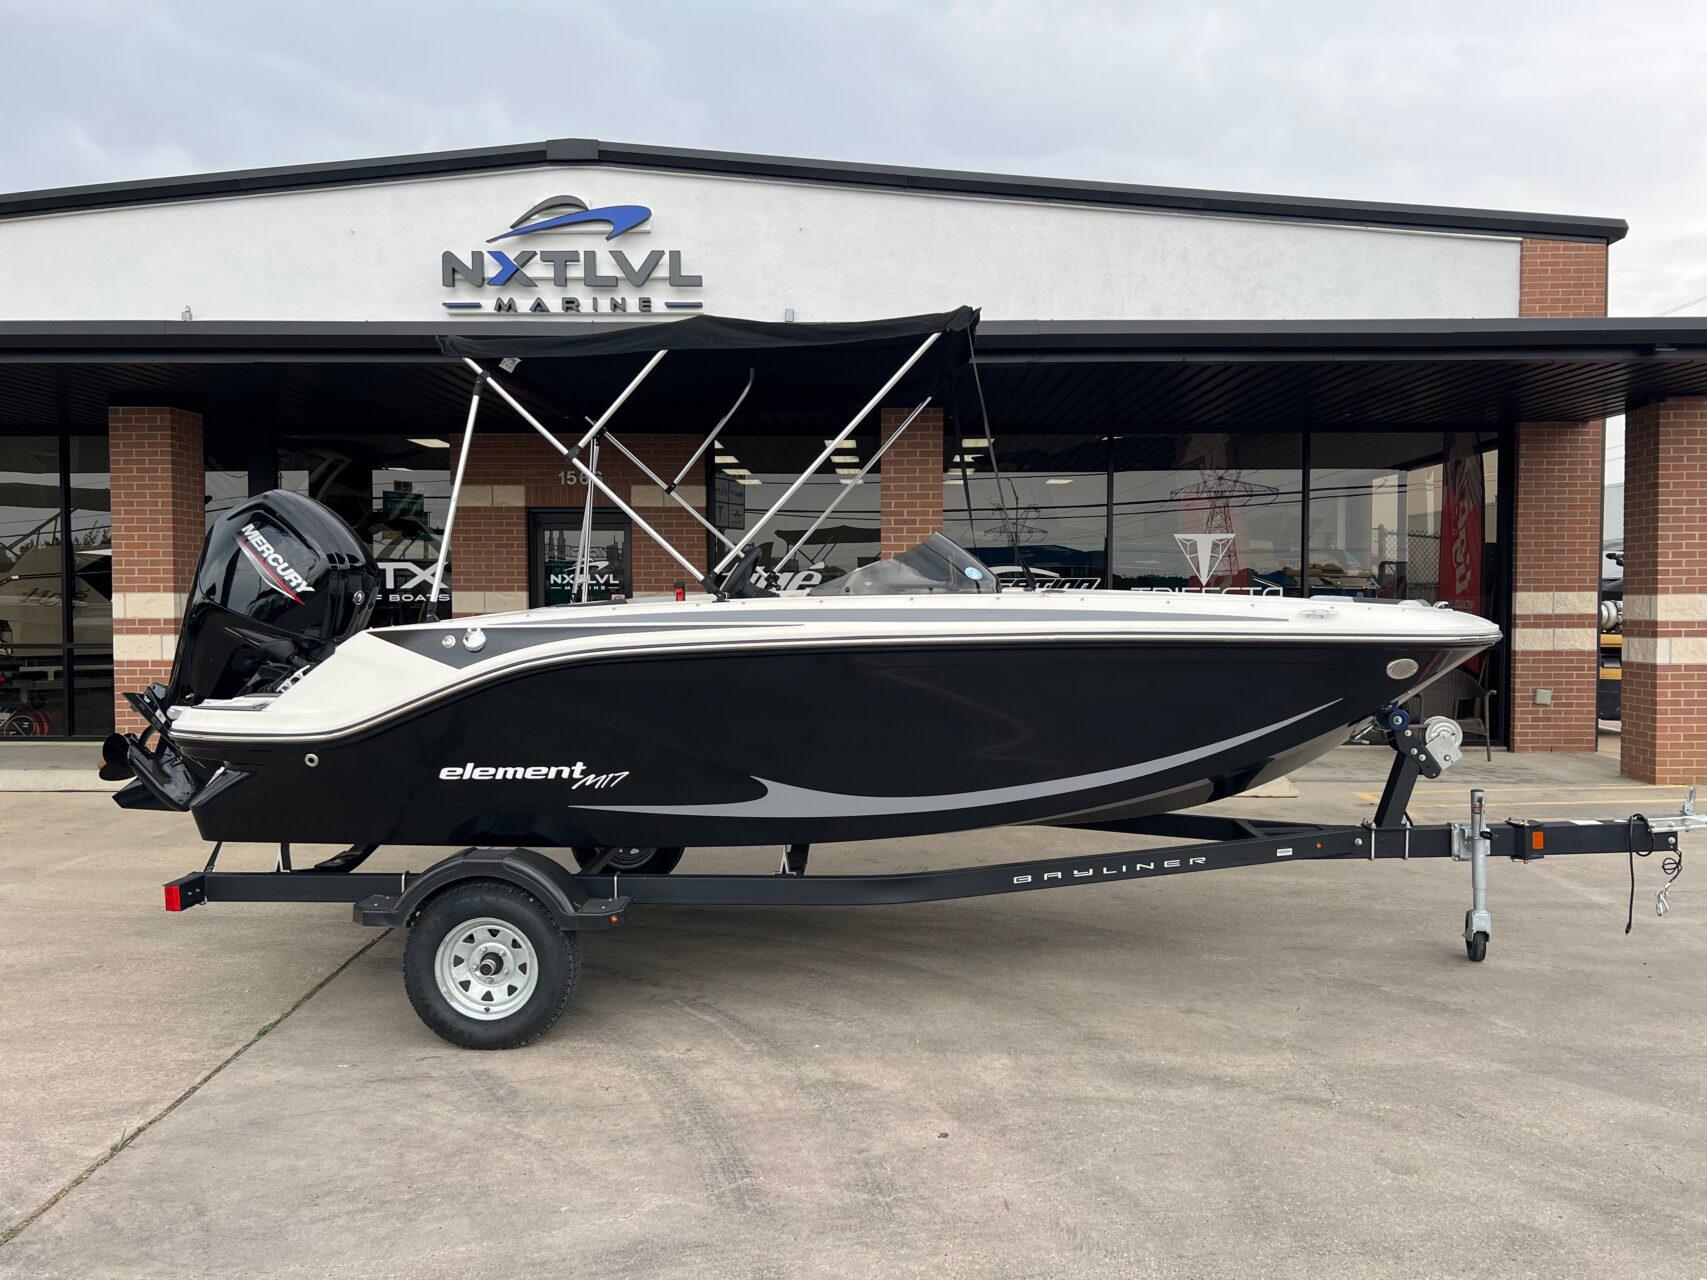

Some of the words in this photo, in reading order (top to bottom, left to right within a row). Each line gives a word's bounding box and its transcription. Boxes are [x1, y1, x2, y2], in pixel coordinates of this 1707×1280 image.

[442, 250, 703, 288] NXTLVL
[493, 297, 652, 313] MARINE
[241, 523, 316, 593] MERCURY
[388, 593, 450, 602] BOAS
[438, 761, 587, 780] element
[571, 771, 630, 790] M17
[1013, 856, 1206, 884] BAYLINER
